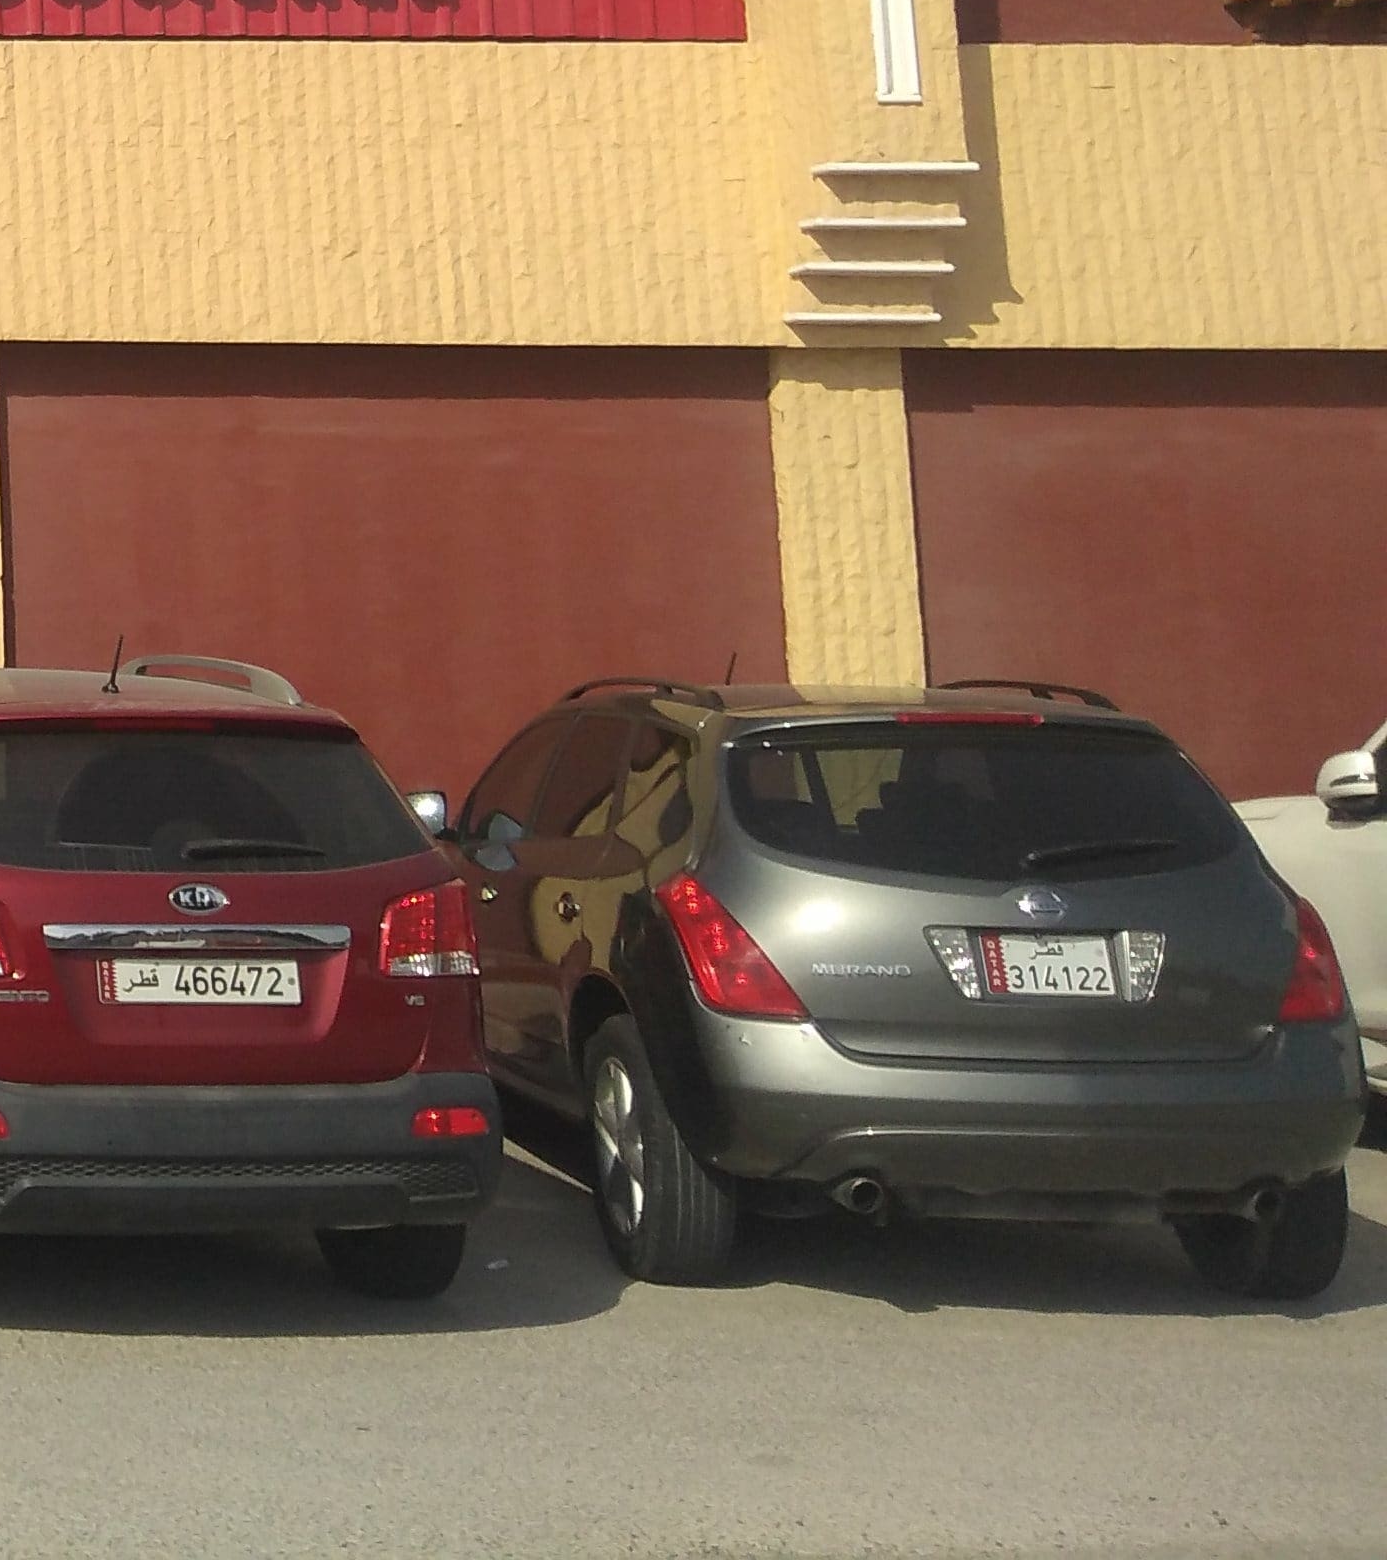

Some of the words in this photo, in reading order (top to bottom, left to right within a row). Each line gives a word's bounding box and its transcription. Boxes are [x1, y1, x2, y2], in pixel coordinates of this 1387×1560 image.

[122, 962, 160, 993] قطر
[811, 962, 912, 976] MURANO
[986, 940, 1002, 987] QATAR
[1009, 965, 1110, 992] 314122
[174, 964, 284, 997] 466472
